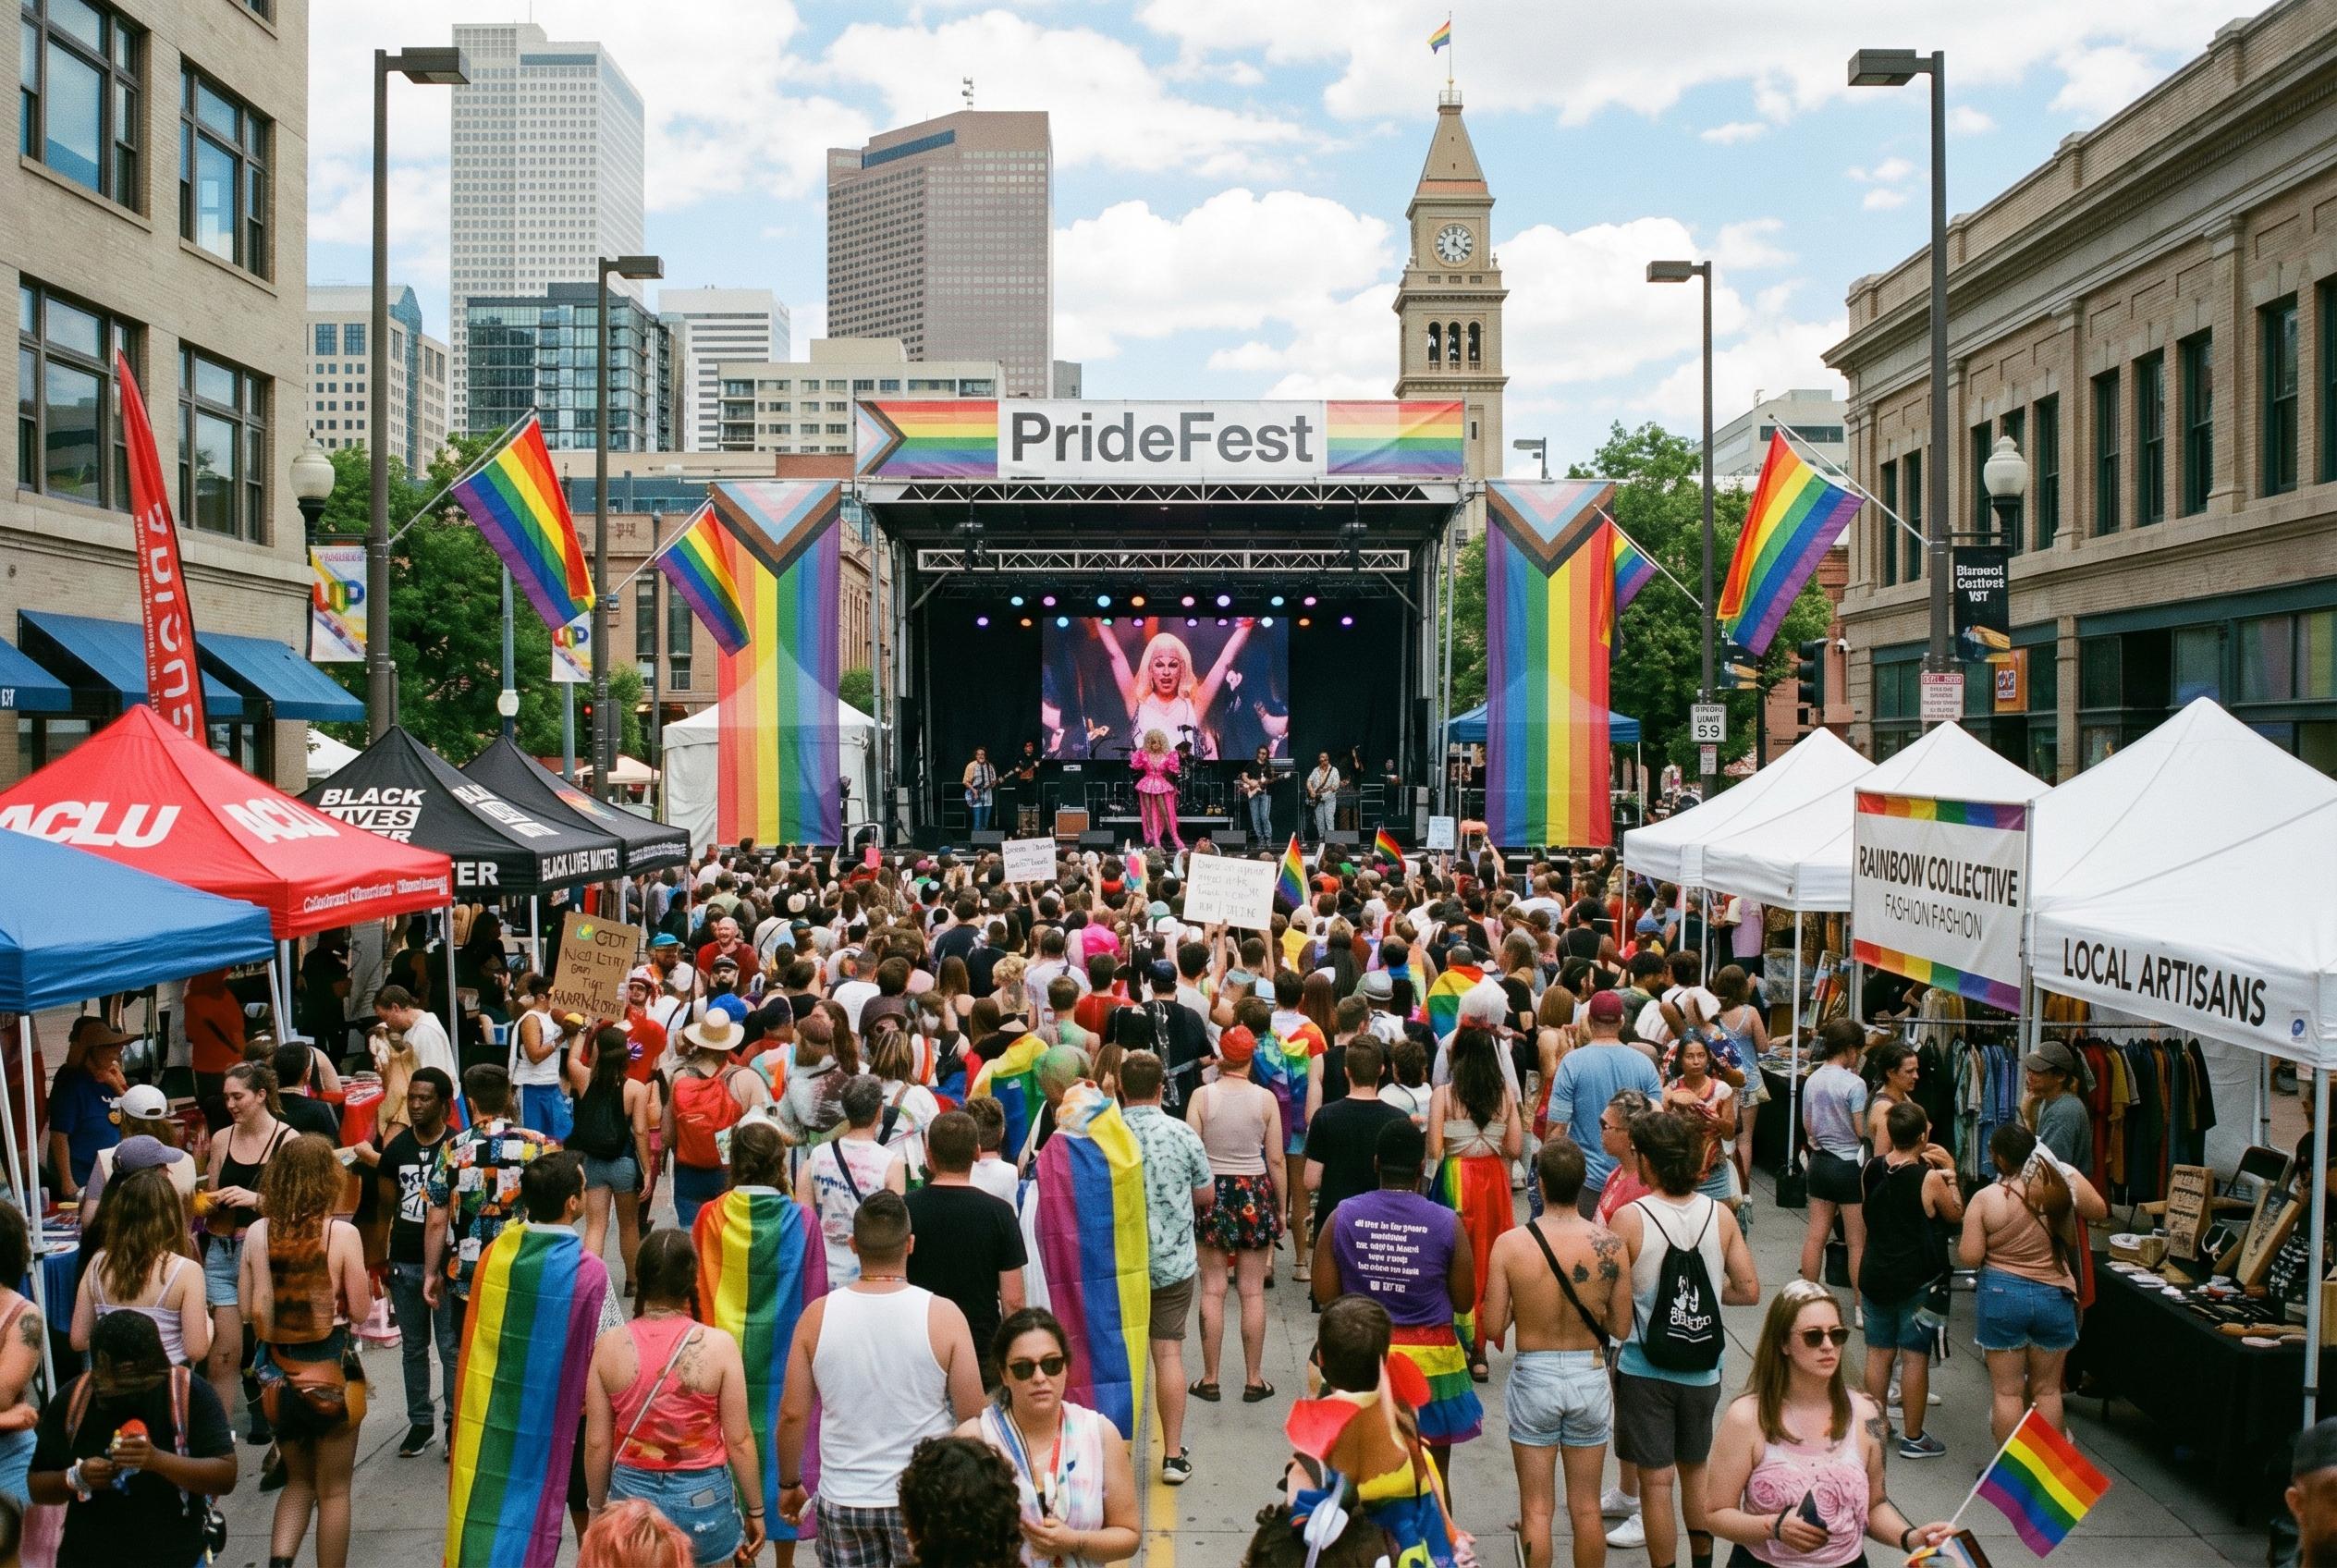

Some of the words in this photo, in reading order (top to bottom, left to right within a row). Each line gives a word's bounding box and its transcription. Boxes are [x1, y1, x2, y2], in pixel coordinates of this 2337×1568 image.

[1011, 411, 1314, 463] PrideFest
[319, 787, 427, 806] BLACK
[324, 809, 413, 827] IVES
[0, 800, 182, 849] ACLU
[1859, 845, 1927, 888] RAINBOW
[1927, 855, 2018, 908] COLLECTIVE
[1885, 893, 1930, 928] FASHION
[1931, 903, 1982, 941] FASHION
[2063, 937, 2132, 991] LOCAL
[2137, 953, 2267, 1027] ARTISANS
